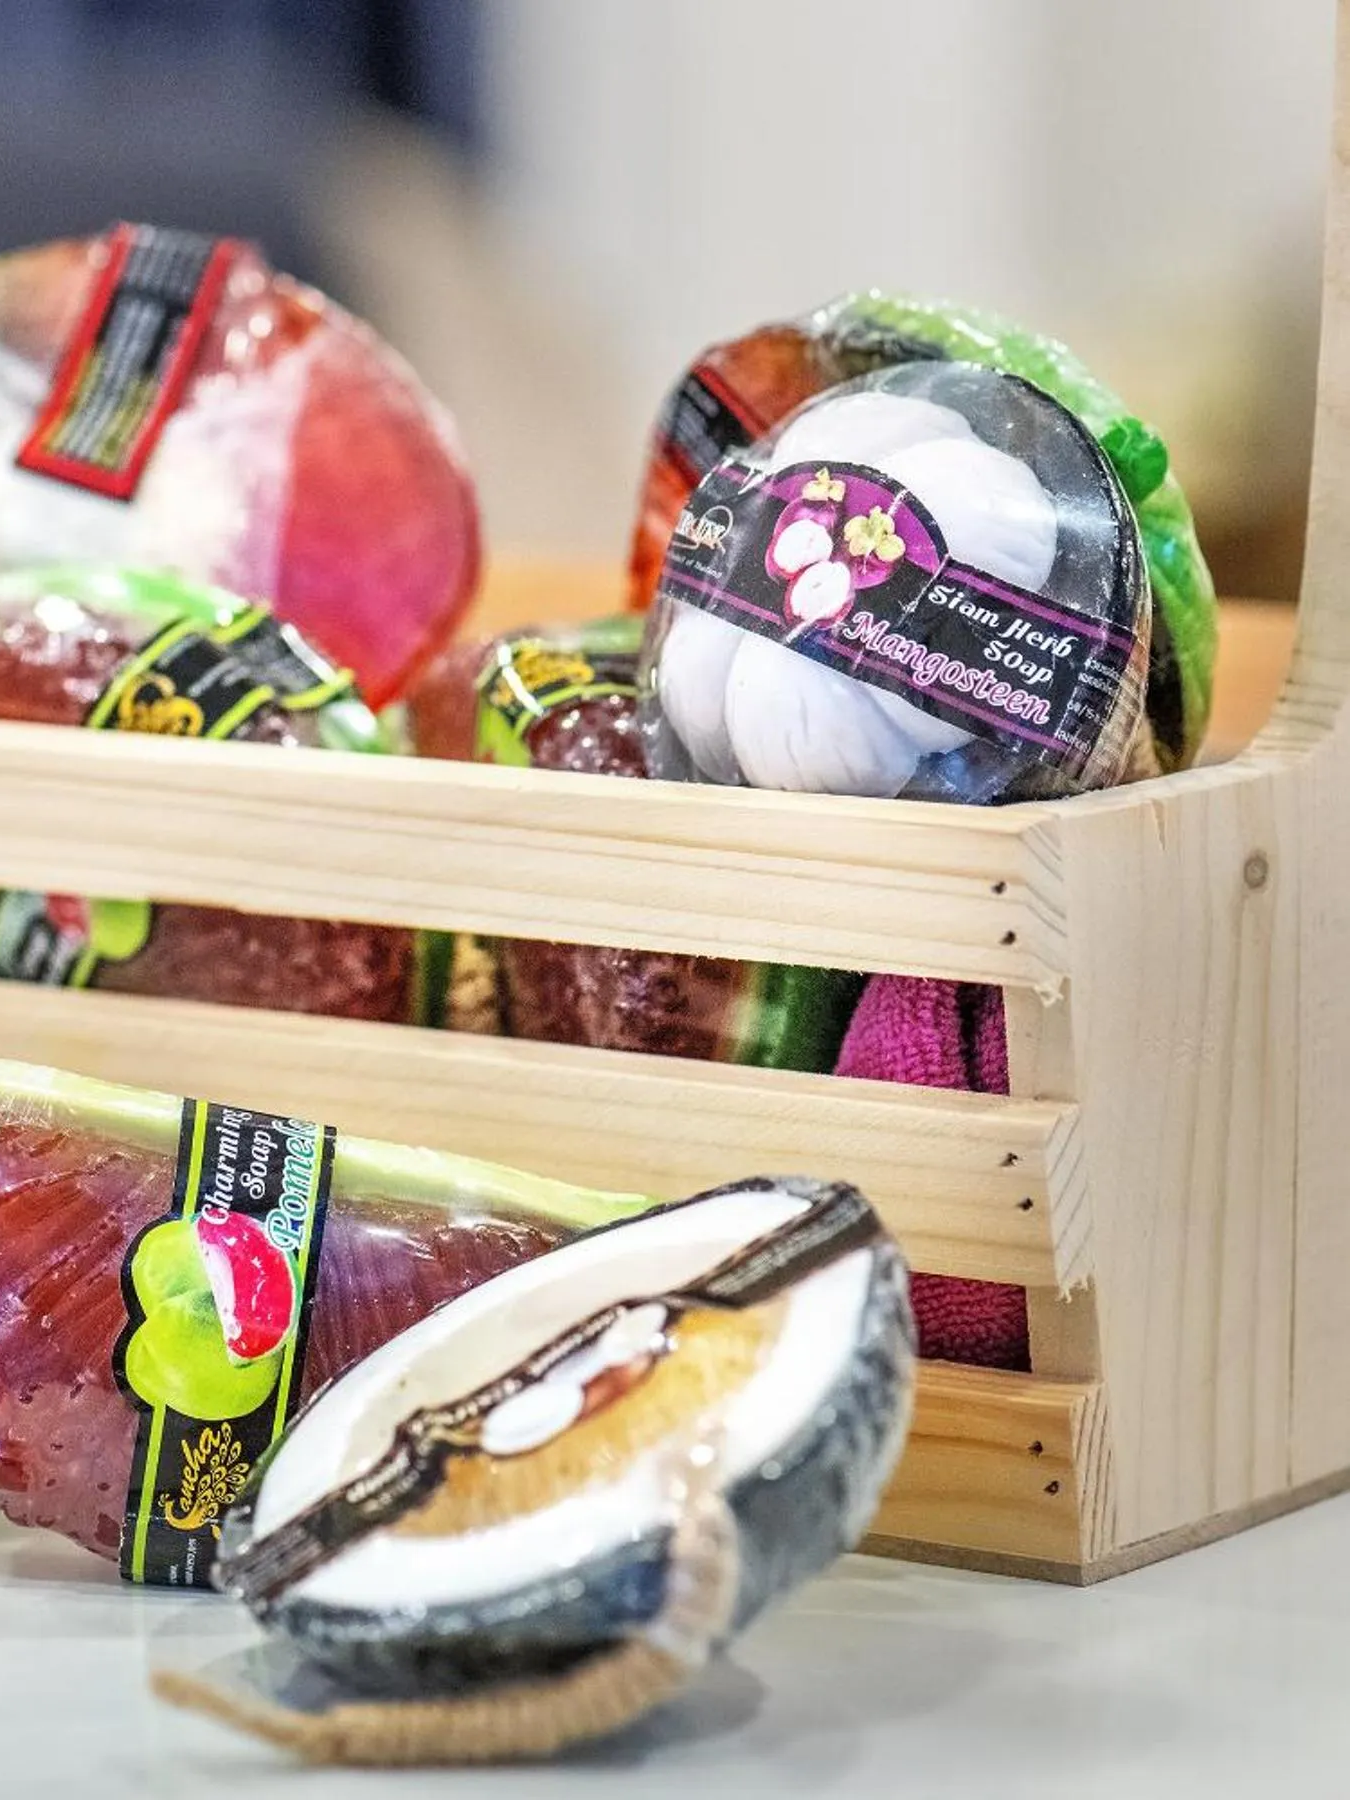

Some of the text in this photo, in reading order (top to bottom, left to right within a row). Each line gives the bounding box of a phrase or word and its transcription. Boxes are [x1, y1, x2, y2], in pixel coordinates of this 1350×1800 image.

[928, 584, 1079, 659] Siam Herb
[842, 611, 1051, 725] Mangosteen
[983, 639, 1054, 685] Soap
[201, 1108, 252, 1226] Charming
[240, 1129, 278, 1200] Soap
